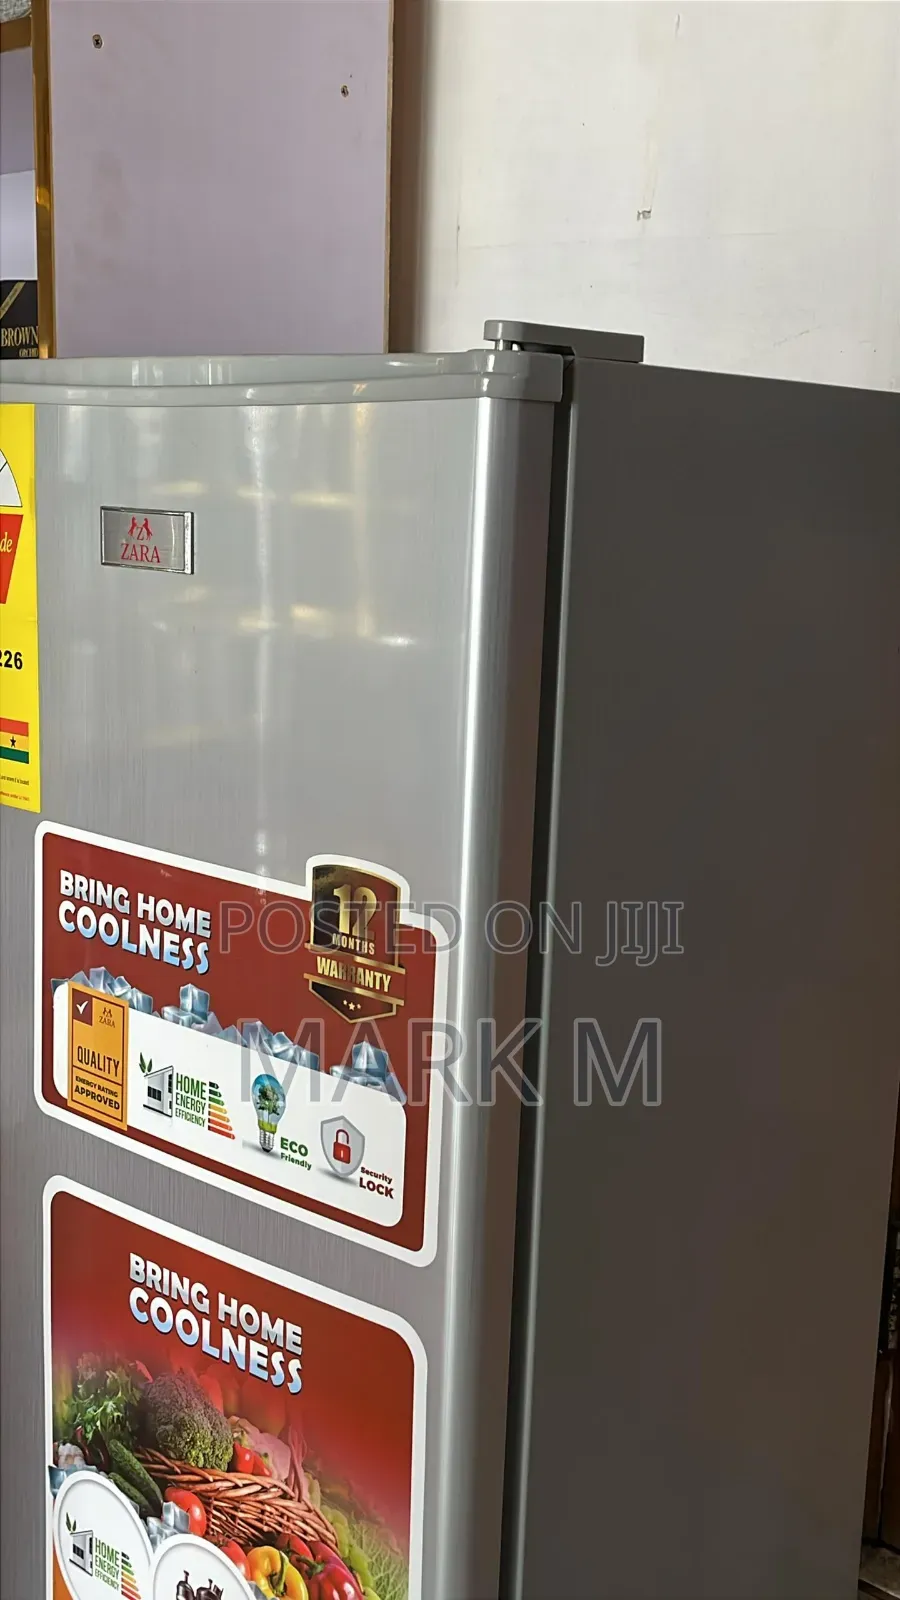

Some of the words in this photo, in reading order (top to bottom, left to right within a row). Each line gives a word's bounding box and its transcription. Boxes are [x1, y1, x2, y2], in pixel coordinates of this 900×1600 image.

[0, 326, 39, 347] BROWN
[120, 543, 161, 564] ZARA
[0, 649, 23, 670] 26
[59, 869, 130, 915] BRING
[137, 892, 212, 939] HOME
[333, 884, 377, 940] 12
[58, 900, 210, 975] COOLNESS
[332, 933, 375, 955] MONTHS
[316, 956, 391, 992] WARRANTY
[99, 1015, 116, 1029] ZARA
[77, 1045, 120, 1078] QUALITY
[74, 1084, 120, 1110] APPROVED
[75, 1075, 97, 1090] ENERGY
[97, 1083, 118, 1098] RATING
[176, 1072, 207, 1100] HOME
[176, 1093, 206, 1115] ENERGY
[175, 1107, 206, 1128] EFFICIENCY
[280, 1136, 308, 1157] ECO
[281, 1152, 312, 1171] Friendly
[360, 1166, 393, 1185] Security
[359, 1176, 394, 1199] LOCK
[129, 1252, 210, 1315] BRING
[218, 1291, 302, 1356] HOME
[129, 1286, 303, 1396] COOLNESS
[95, 1537, 120, 1568] HOME
[95, 1554, 120, 1580] ENERGY
[94, 1568, 120, 1591] EFFICIENCY
